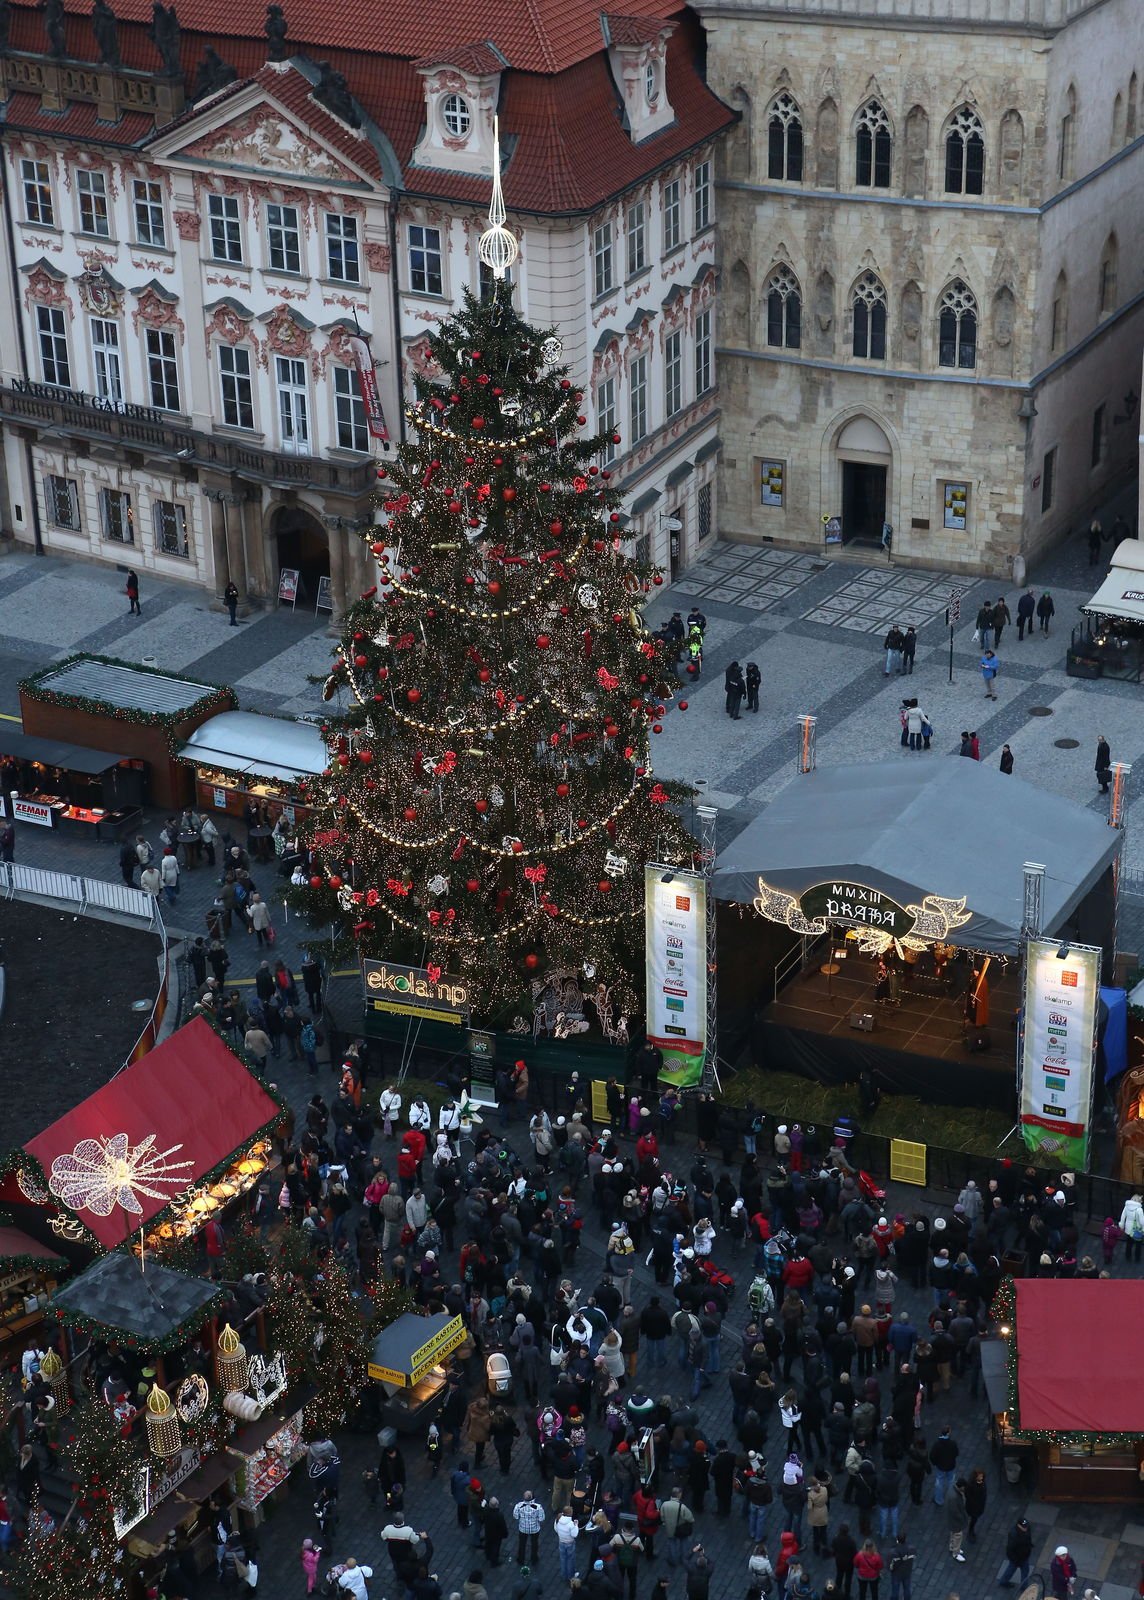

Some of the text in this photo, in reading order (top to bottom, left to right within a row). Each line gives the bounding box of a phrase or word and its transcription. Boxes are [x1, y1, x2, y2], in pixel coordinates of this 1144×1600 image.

[11, 377, 163, 425] NÁRODNÍ GALERIE
[16, 803, 48, 817] ZEMAN
[832, 884, 881, 904] MMXIII
[826, 898, 896, 927] PRAHA
[367, 967, 466, 1006] ekolamp
[1045, 995, 1072, 1006] ekolamp
[1049, 1028, 1066, 1036] metro
[435, 1318, 461, 1343] KAŠTANY
[437, 1331, 464, 1358] KAŠTANY
